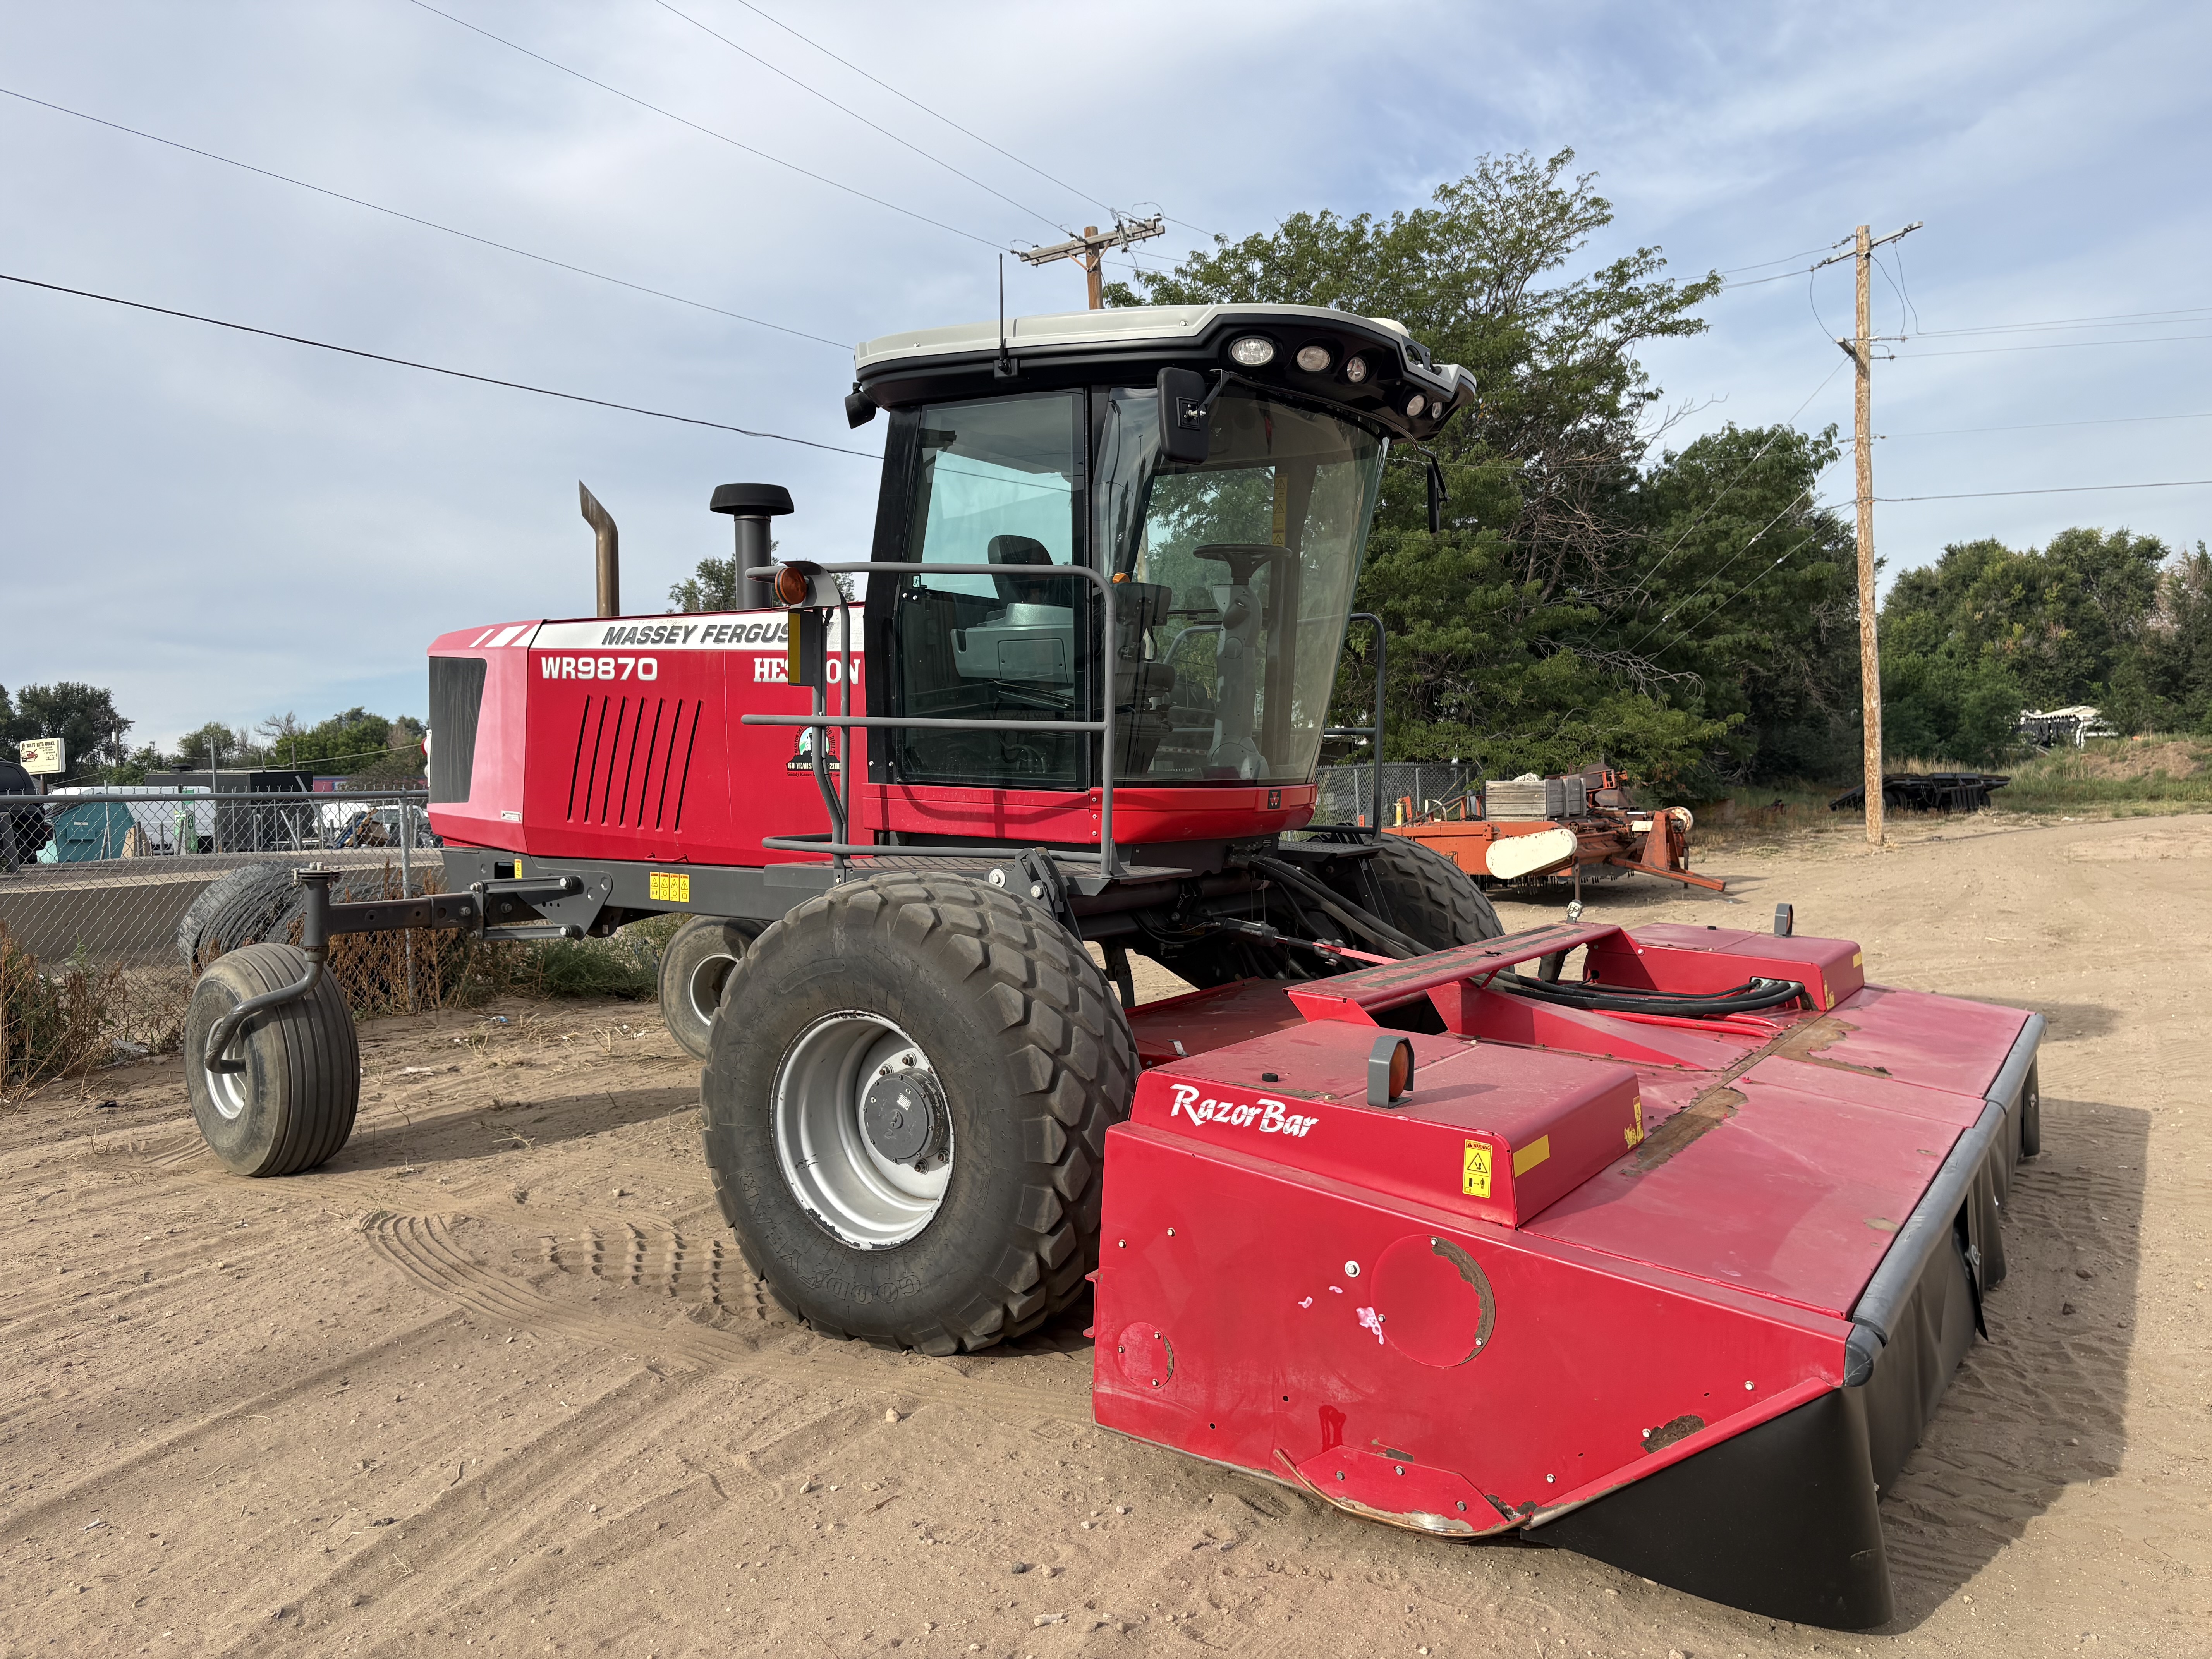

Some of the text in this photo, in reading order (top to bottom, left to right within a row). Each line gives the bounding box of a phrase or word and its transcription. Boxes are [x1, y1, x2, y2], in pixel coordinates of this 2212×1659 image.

[601, 623, 835, 645] MASSEY FERGUS
[541, 657, 658, 681] WR9870
[753, 658, 860, 685] HEON
[1170, 1083, 1319, 1137] RazorBar
[740, 1172, 921, 1304] GOODYEAR
